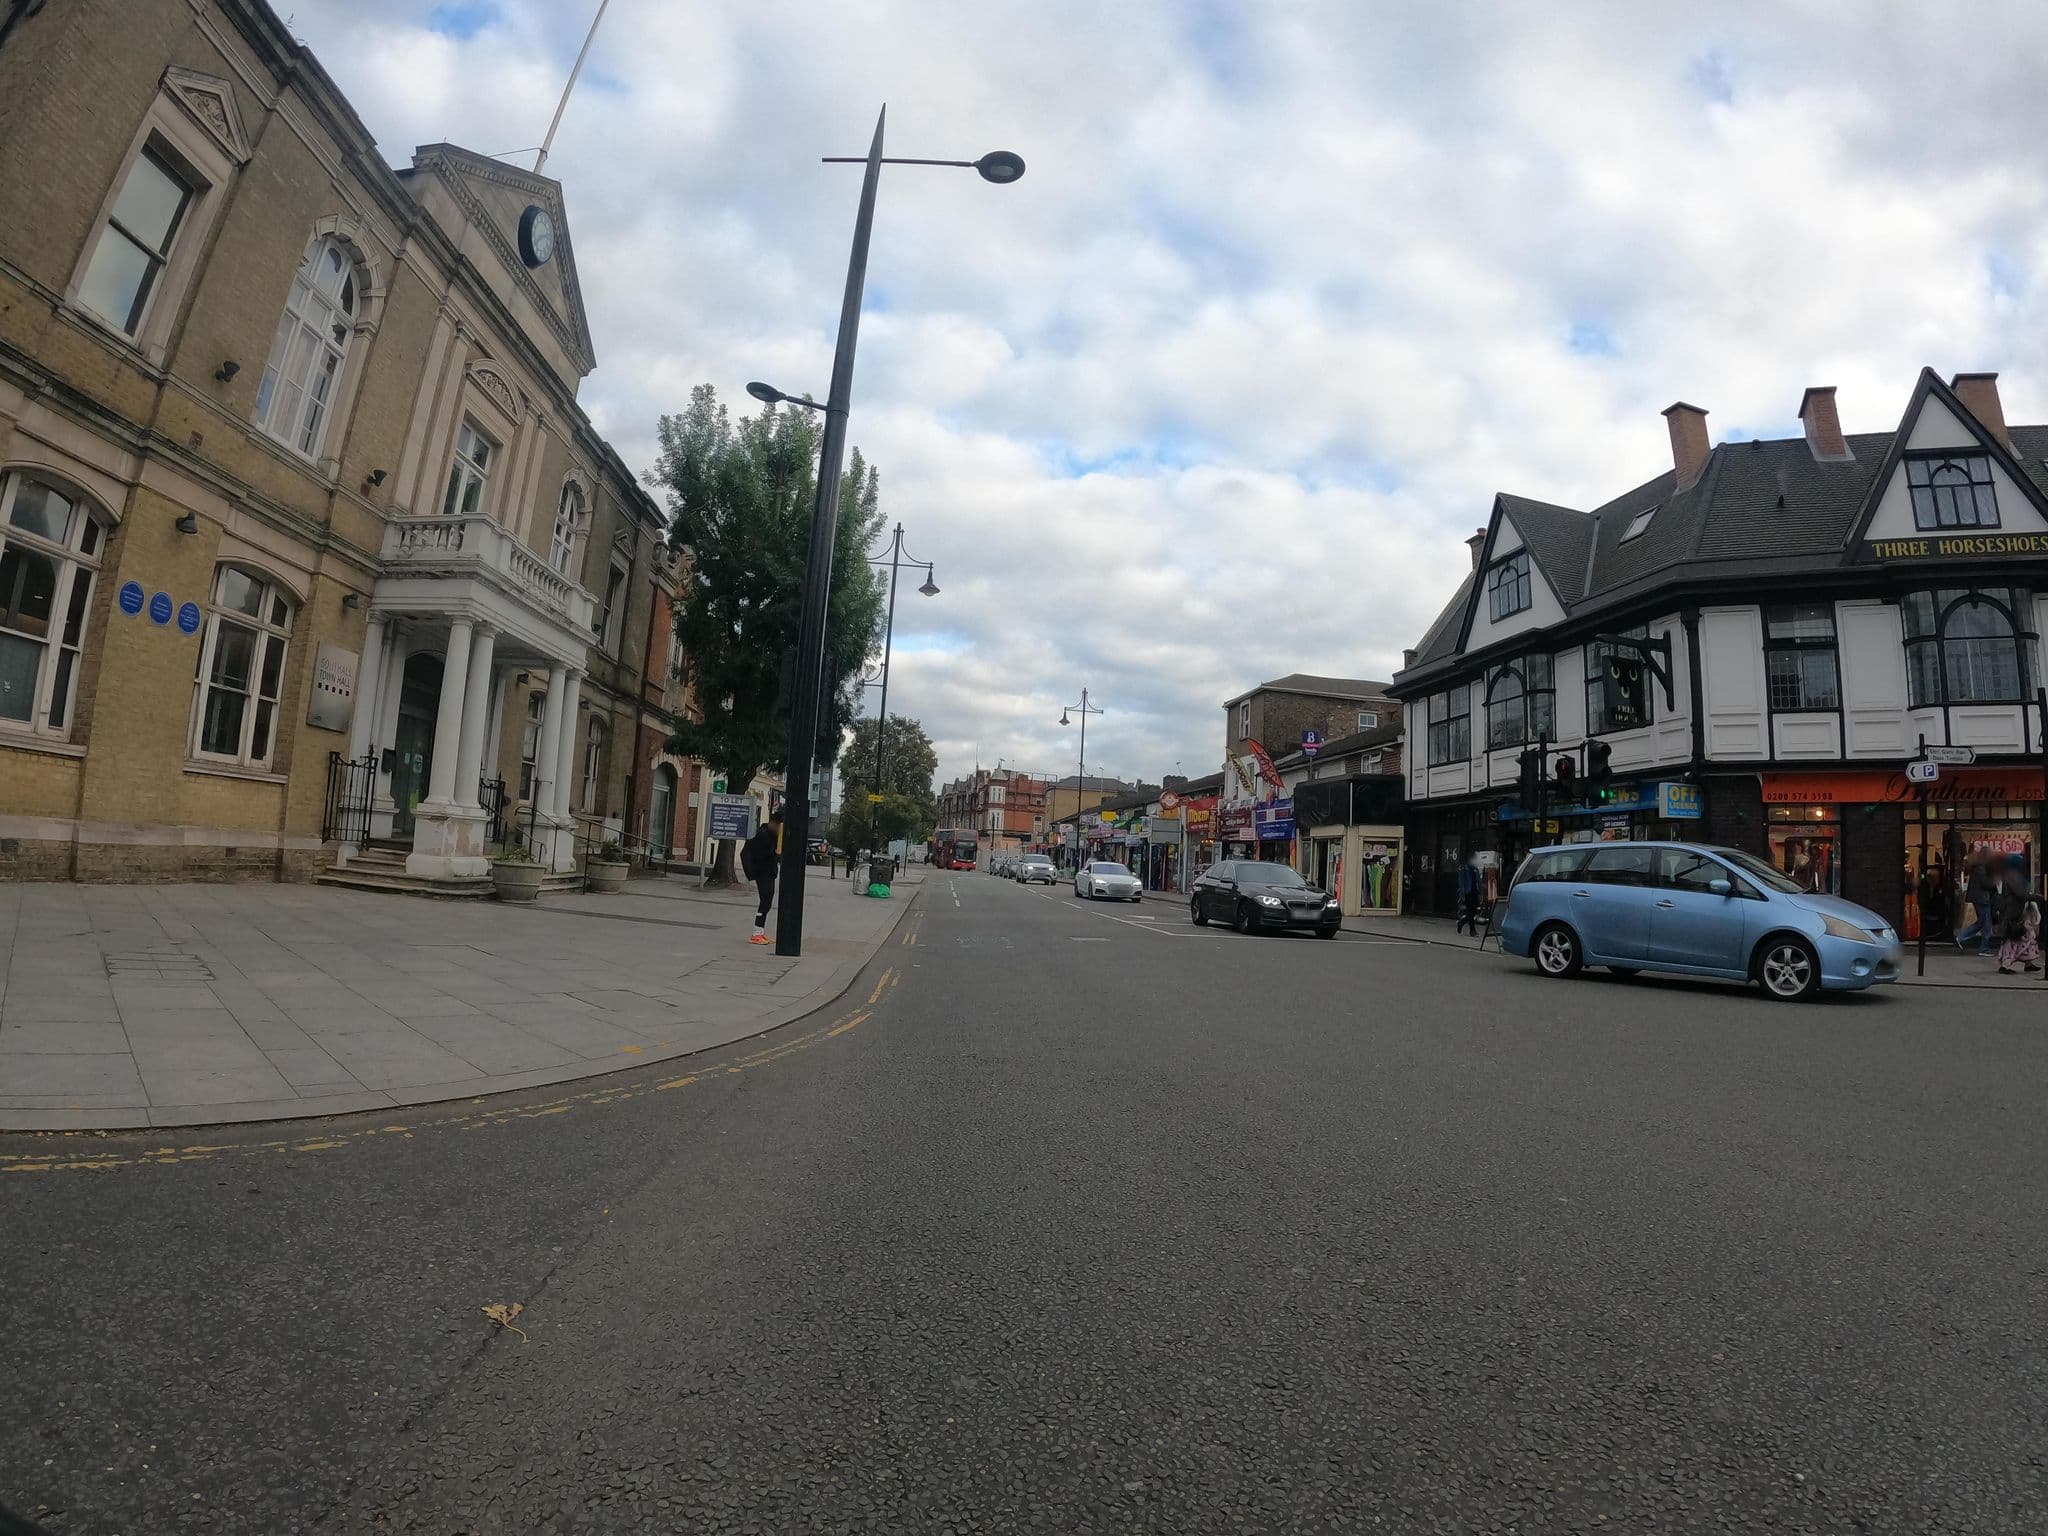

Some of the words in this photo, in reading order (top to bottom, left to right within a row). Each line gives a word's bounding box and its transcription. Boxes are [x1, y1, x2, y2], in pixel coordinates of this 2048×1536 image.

[1872, 540, 1930, 557] THREE
[1938, 536, 2048, 554] HORSESHOES
[319, 669, 336, 683] TOWN
[1925, 766, 1933, 776] P
[1669, 785, 1697, 801] OFF
[1974, 840, 2002, 852] SALE
[1444, 848, 1458, 860] 1-6
